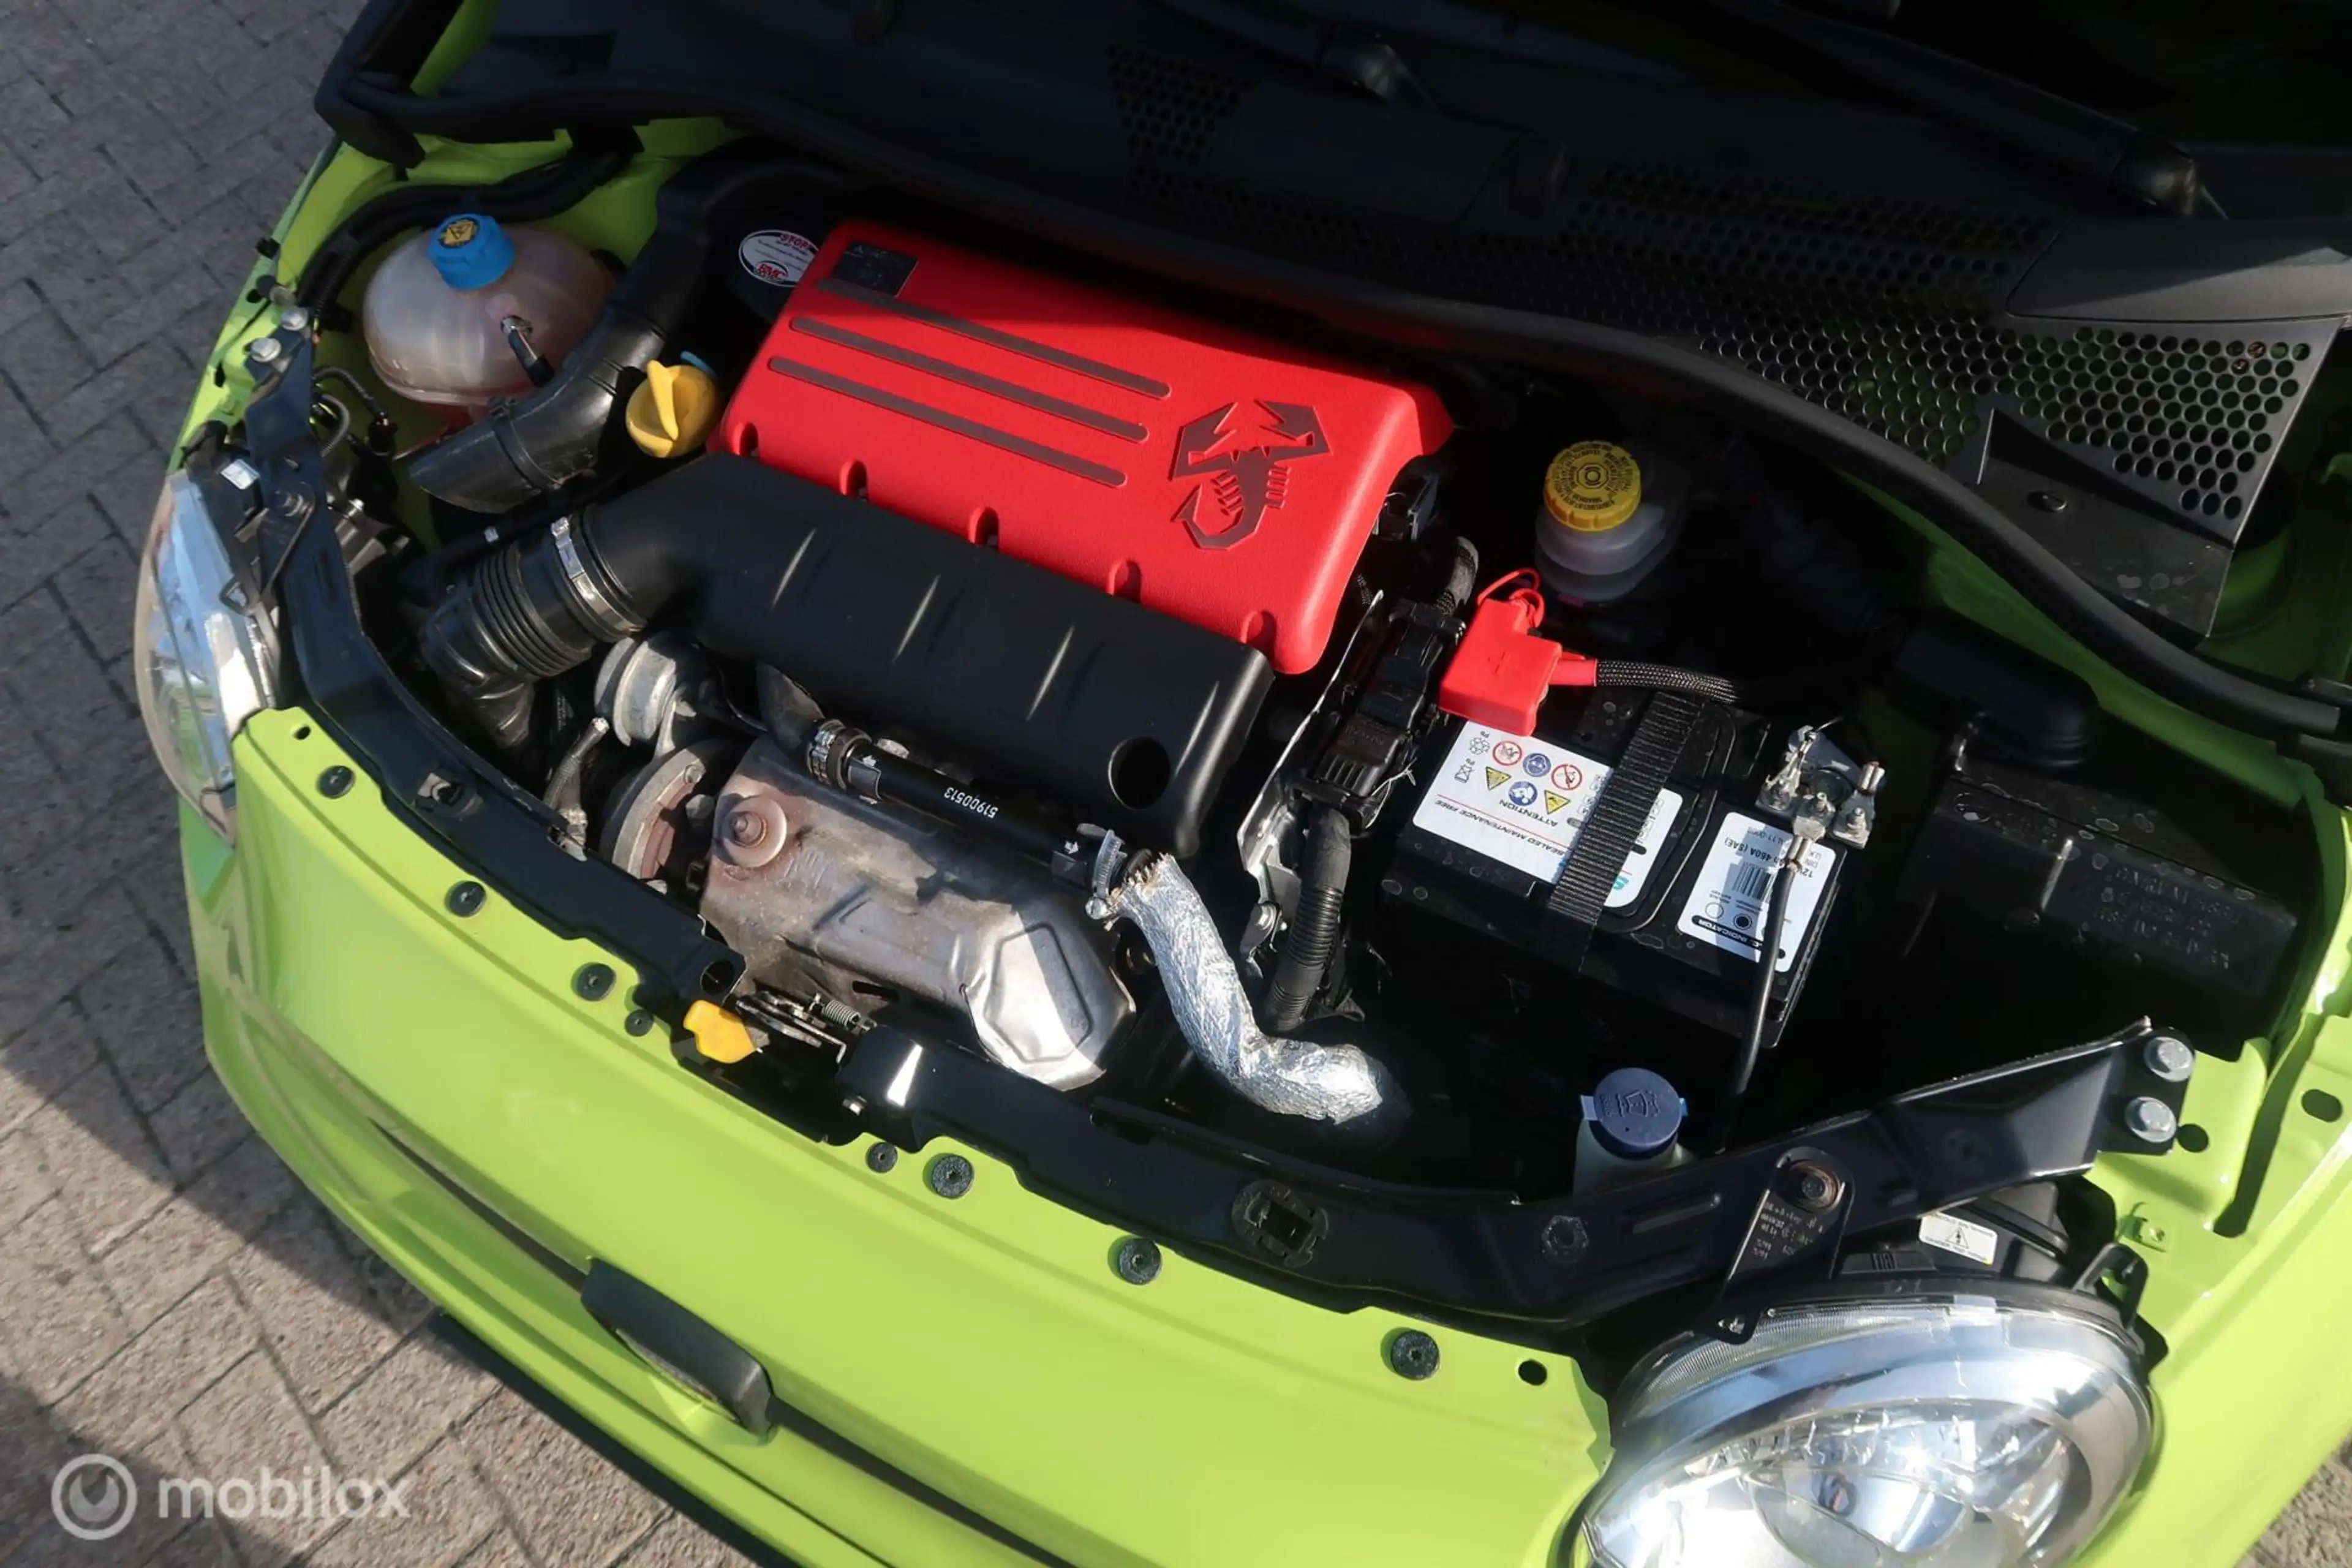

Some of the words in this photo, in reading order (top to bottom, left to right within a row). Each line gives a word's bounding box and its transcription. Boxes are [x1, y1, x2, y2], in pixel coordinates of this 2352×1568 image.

[944, 787, 998, 818] 51900513
[1434, 799, 1459, 812] FREE
[1499, 799, 1558, 827] ATTENTION
[1460, 809, 1525, 840] MAINTENANCE
[1528, 837, 1566, 856] SEALED
[1724, 836, 1749, 852] (SAE)
[1698, 919, 1749, 943] INDICATOR
